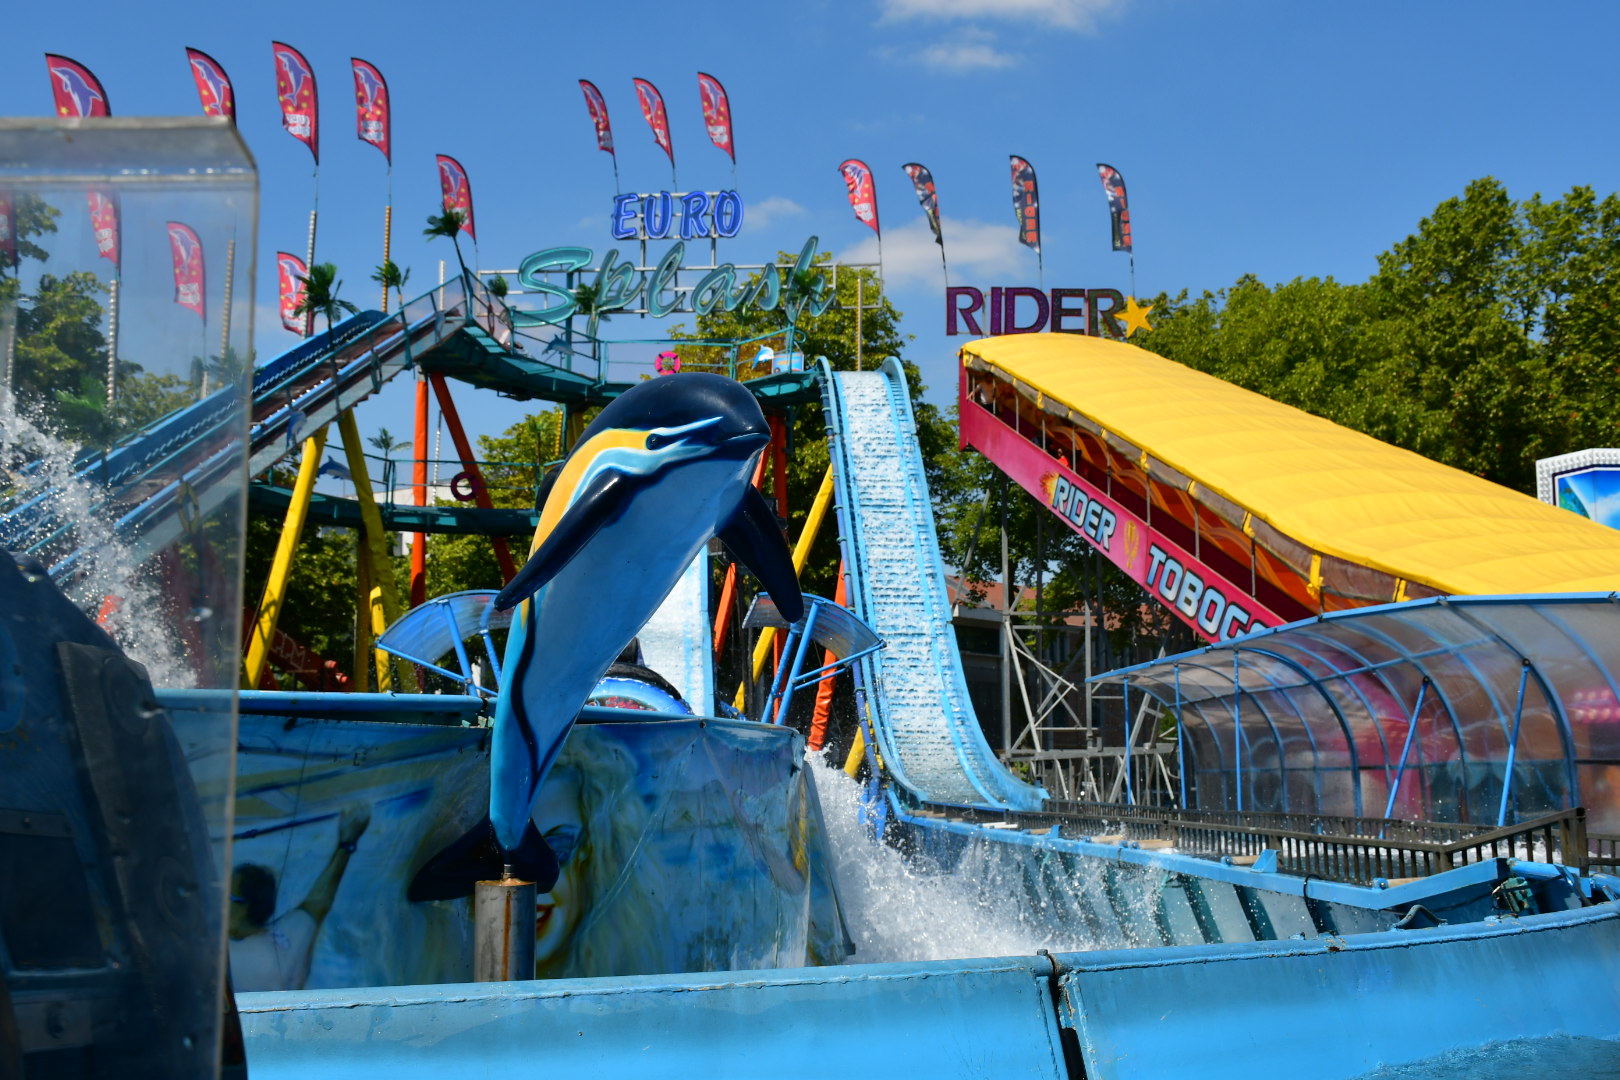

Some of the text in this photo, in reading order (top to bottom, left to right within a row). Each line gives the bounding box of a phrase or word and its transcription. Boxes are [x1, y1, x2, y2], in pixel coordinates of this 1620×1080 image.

[611, 190, 744, 240] EURO
[513, 236, 836, 342] Splash
[946, 286, 1125, 337] RIDER
[1052, 473, 1270, 642] RIDER TOBOG
